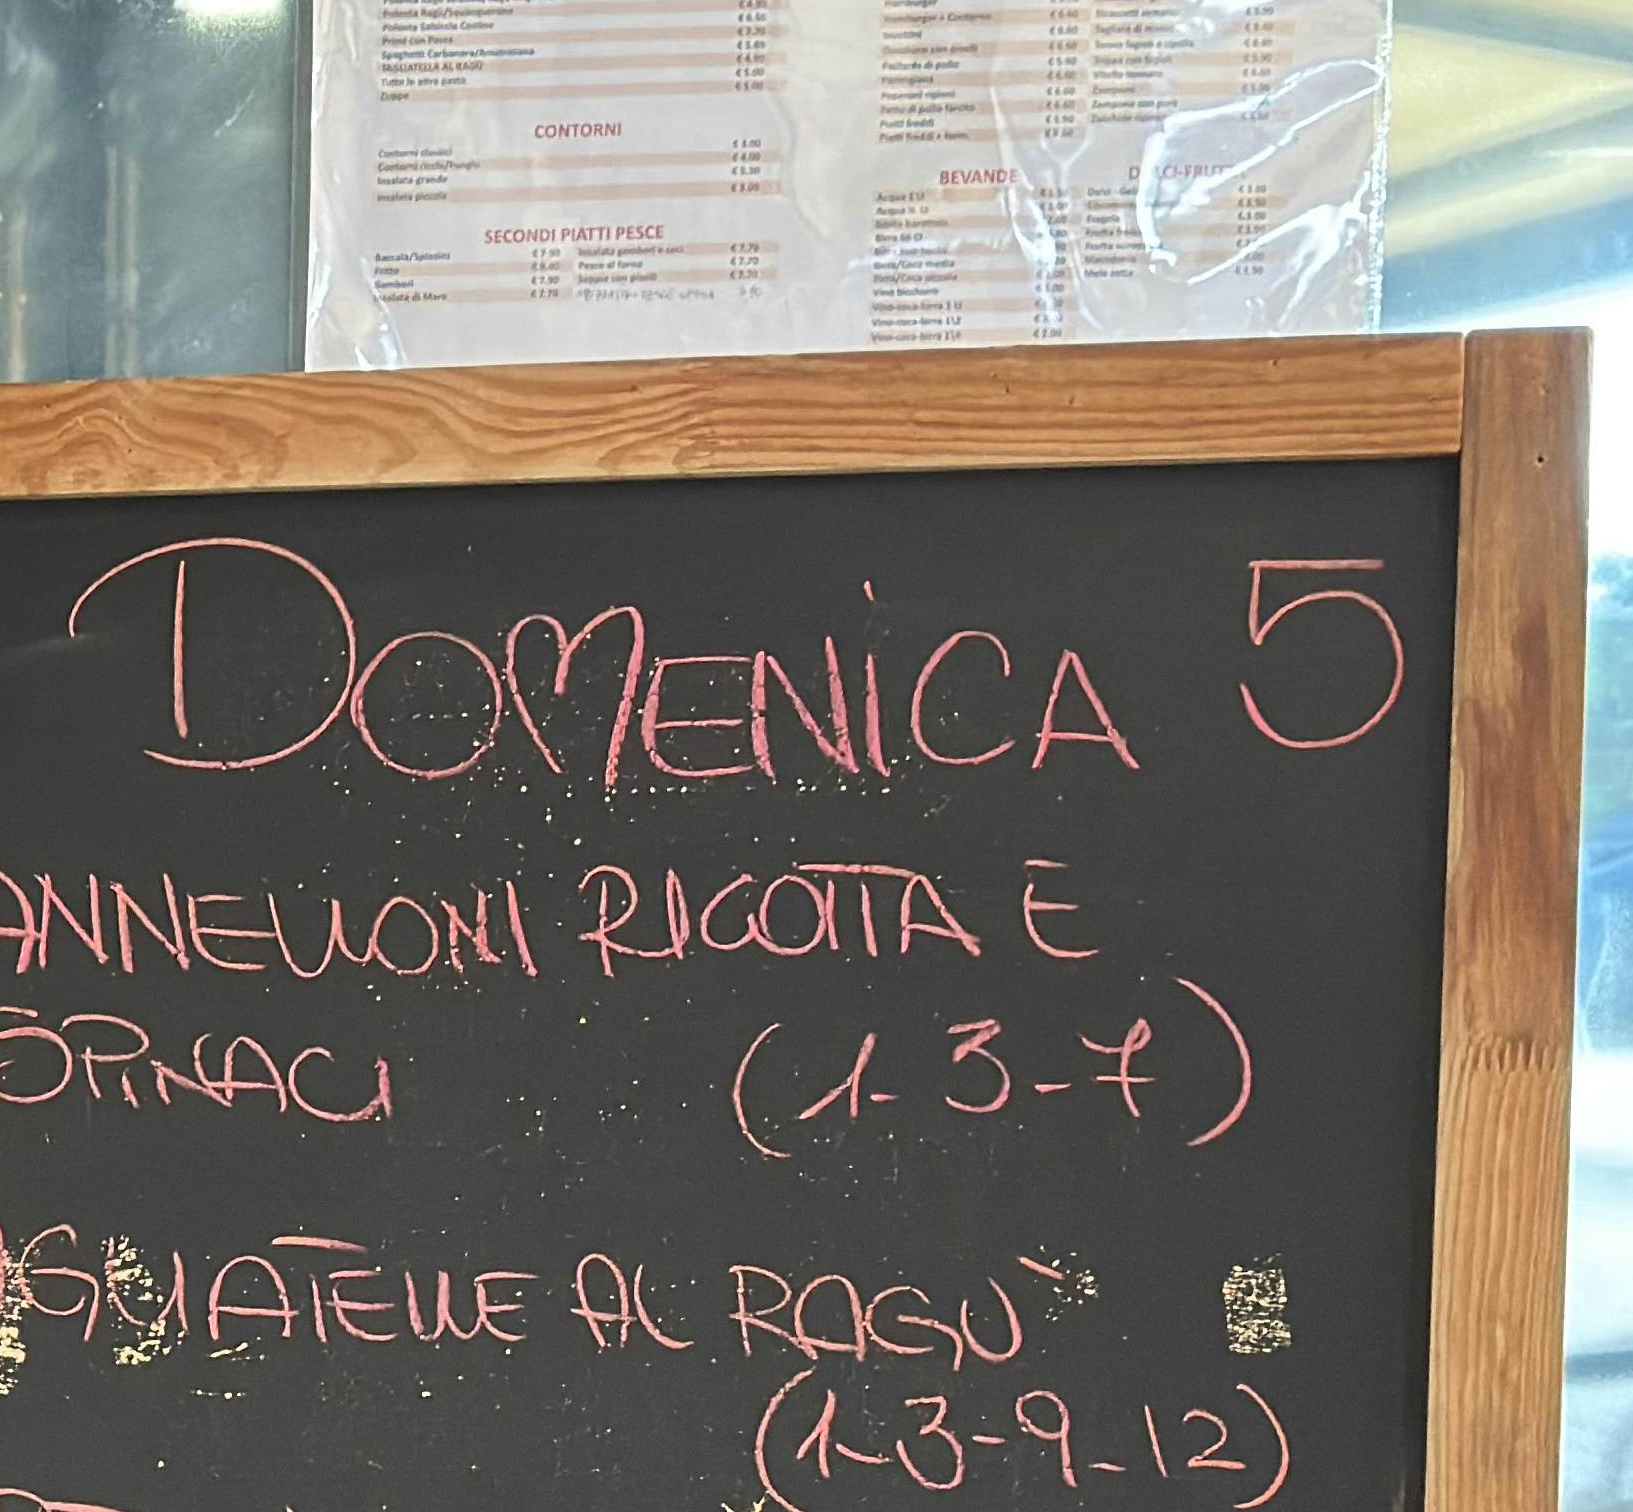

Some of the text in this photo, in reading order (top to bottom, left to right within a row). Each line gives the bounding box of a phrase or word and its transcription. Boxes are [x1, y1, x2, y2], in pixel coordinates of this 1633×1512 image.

[534, 122, 622, 140] CONTORNI
[939, 169, 1018, 186] BEVANDE
[484, 224, 665, 245] SECONDI PIATTI PESCE
[69, 538, 1405, 791] DOMENICA 5
[576, 861, 981, 977] RICOTTA
[1023, 860, 1100, 958] E
[572, 1253, 694, 1351] AL
